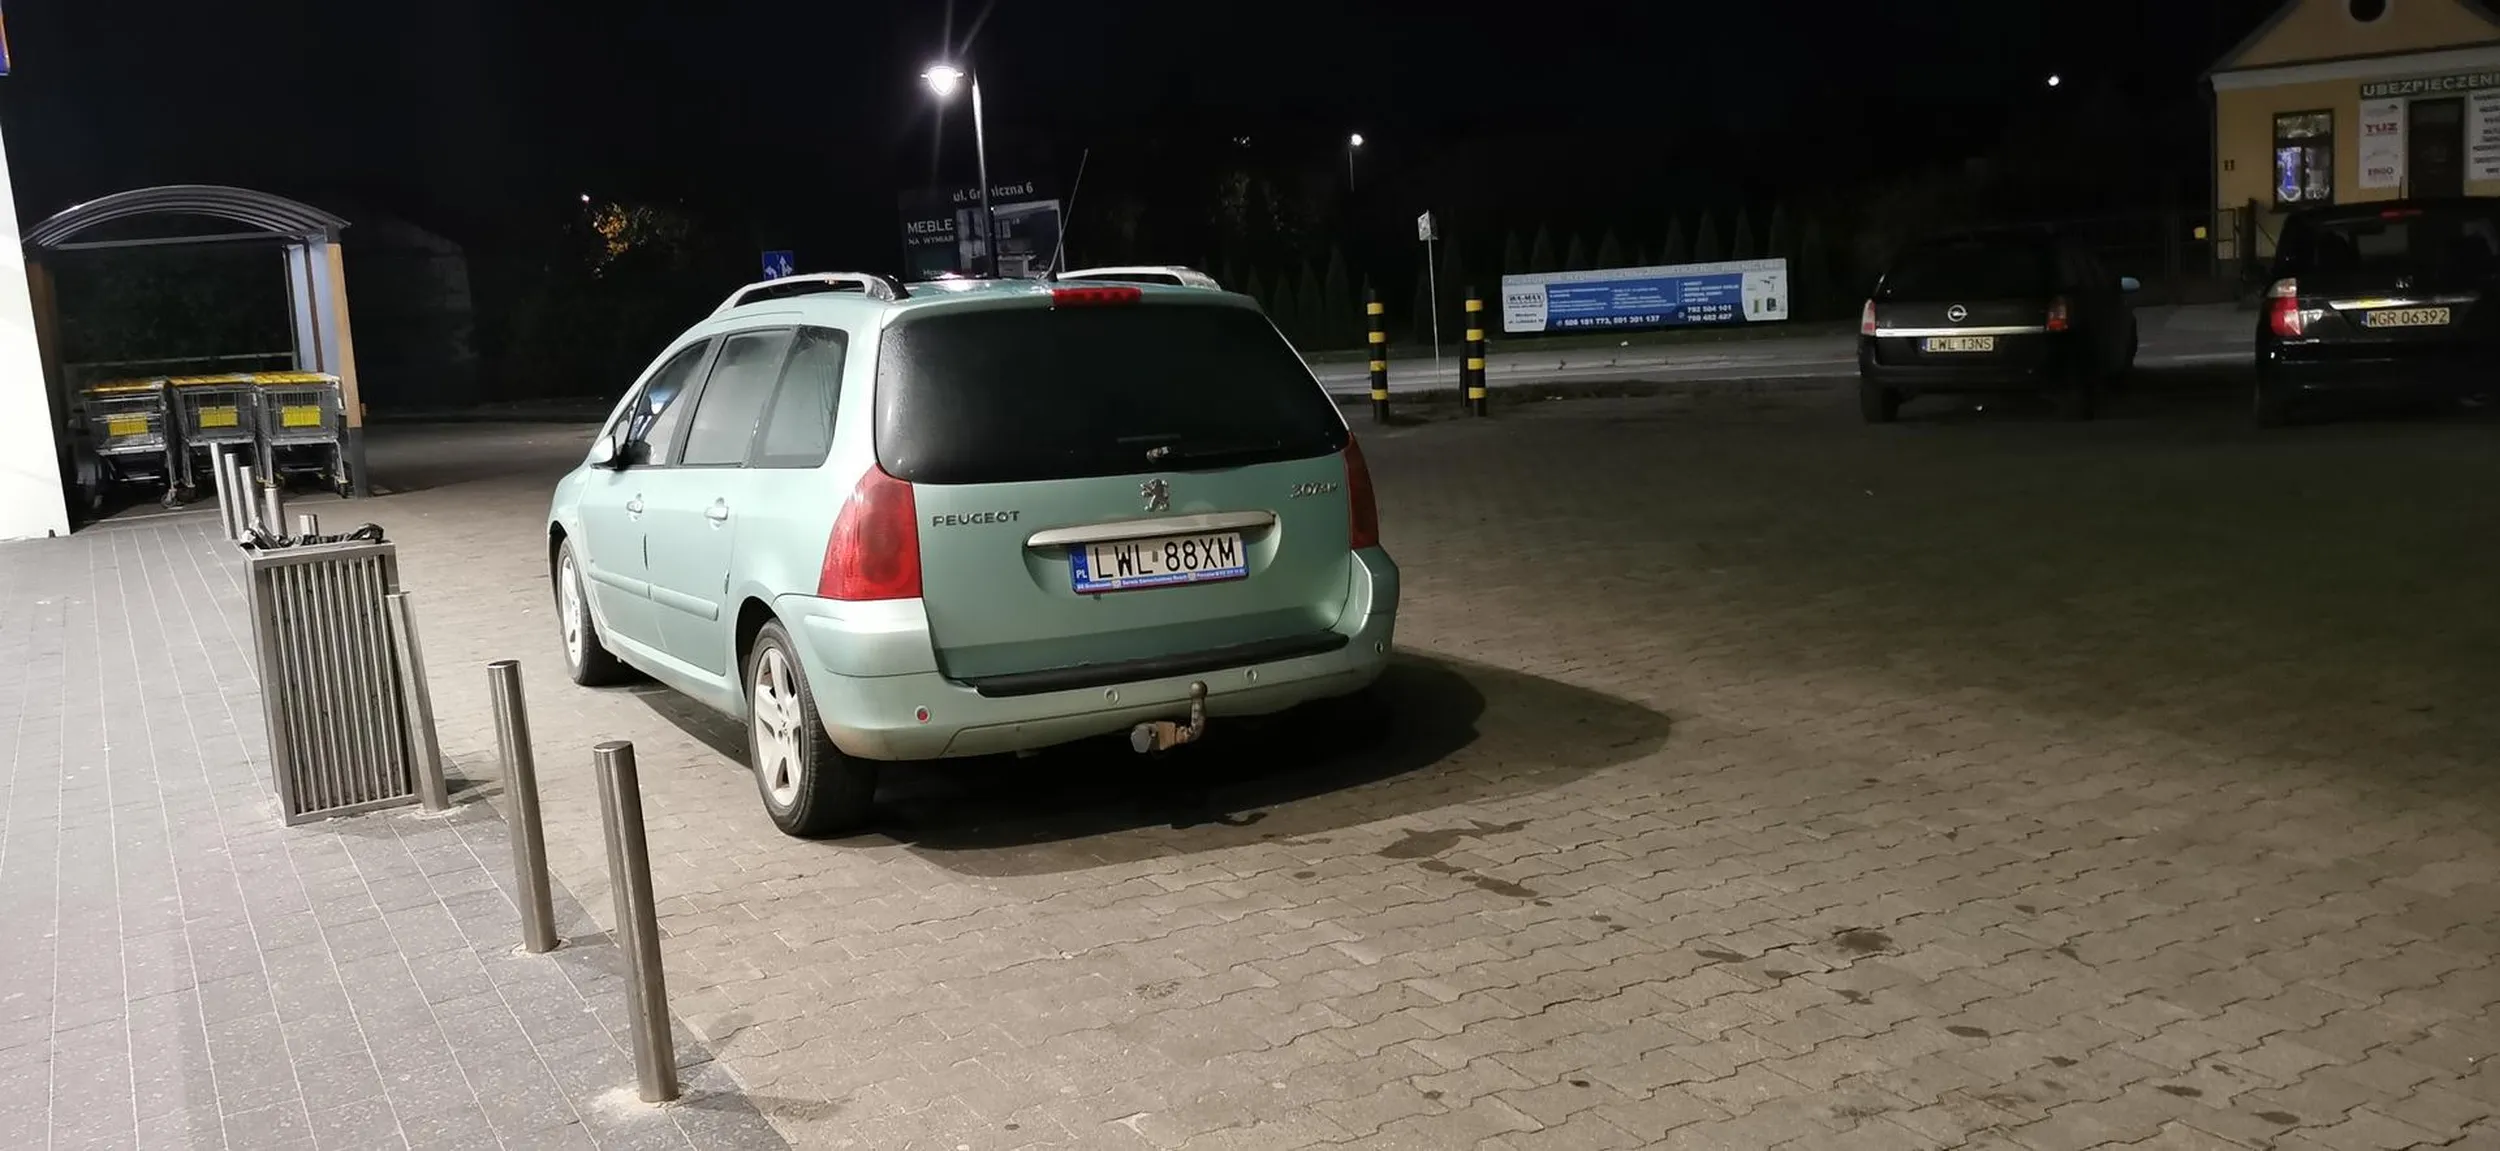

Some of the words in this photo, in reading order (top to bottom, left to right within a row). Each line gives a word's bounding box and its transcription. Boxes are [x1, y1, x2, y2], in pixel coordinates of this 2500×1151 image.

[953, 189, 967, 202] ul.
[969, 184, 1024, 200] Griczna
[1026, 181, 1034, 194] 6
[907, 218, 954, 234] MEBLE
[2369, 310, 2397, 325] WGR
[2401, 308, 2448, 324] 06392
[1929, 339, 1955, 350] LWL
[1962, 337, 1992, 349] 13NS
[932, 510, 1020, 527] PEUGEOT
[1094, 544, 1154, 578] LWL
[1164, 537, 1236, 571] 88XM
[1076, 569, 1088, 579] PL
